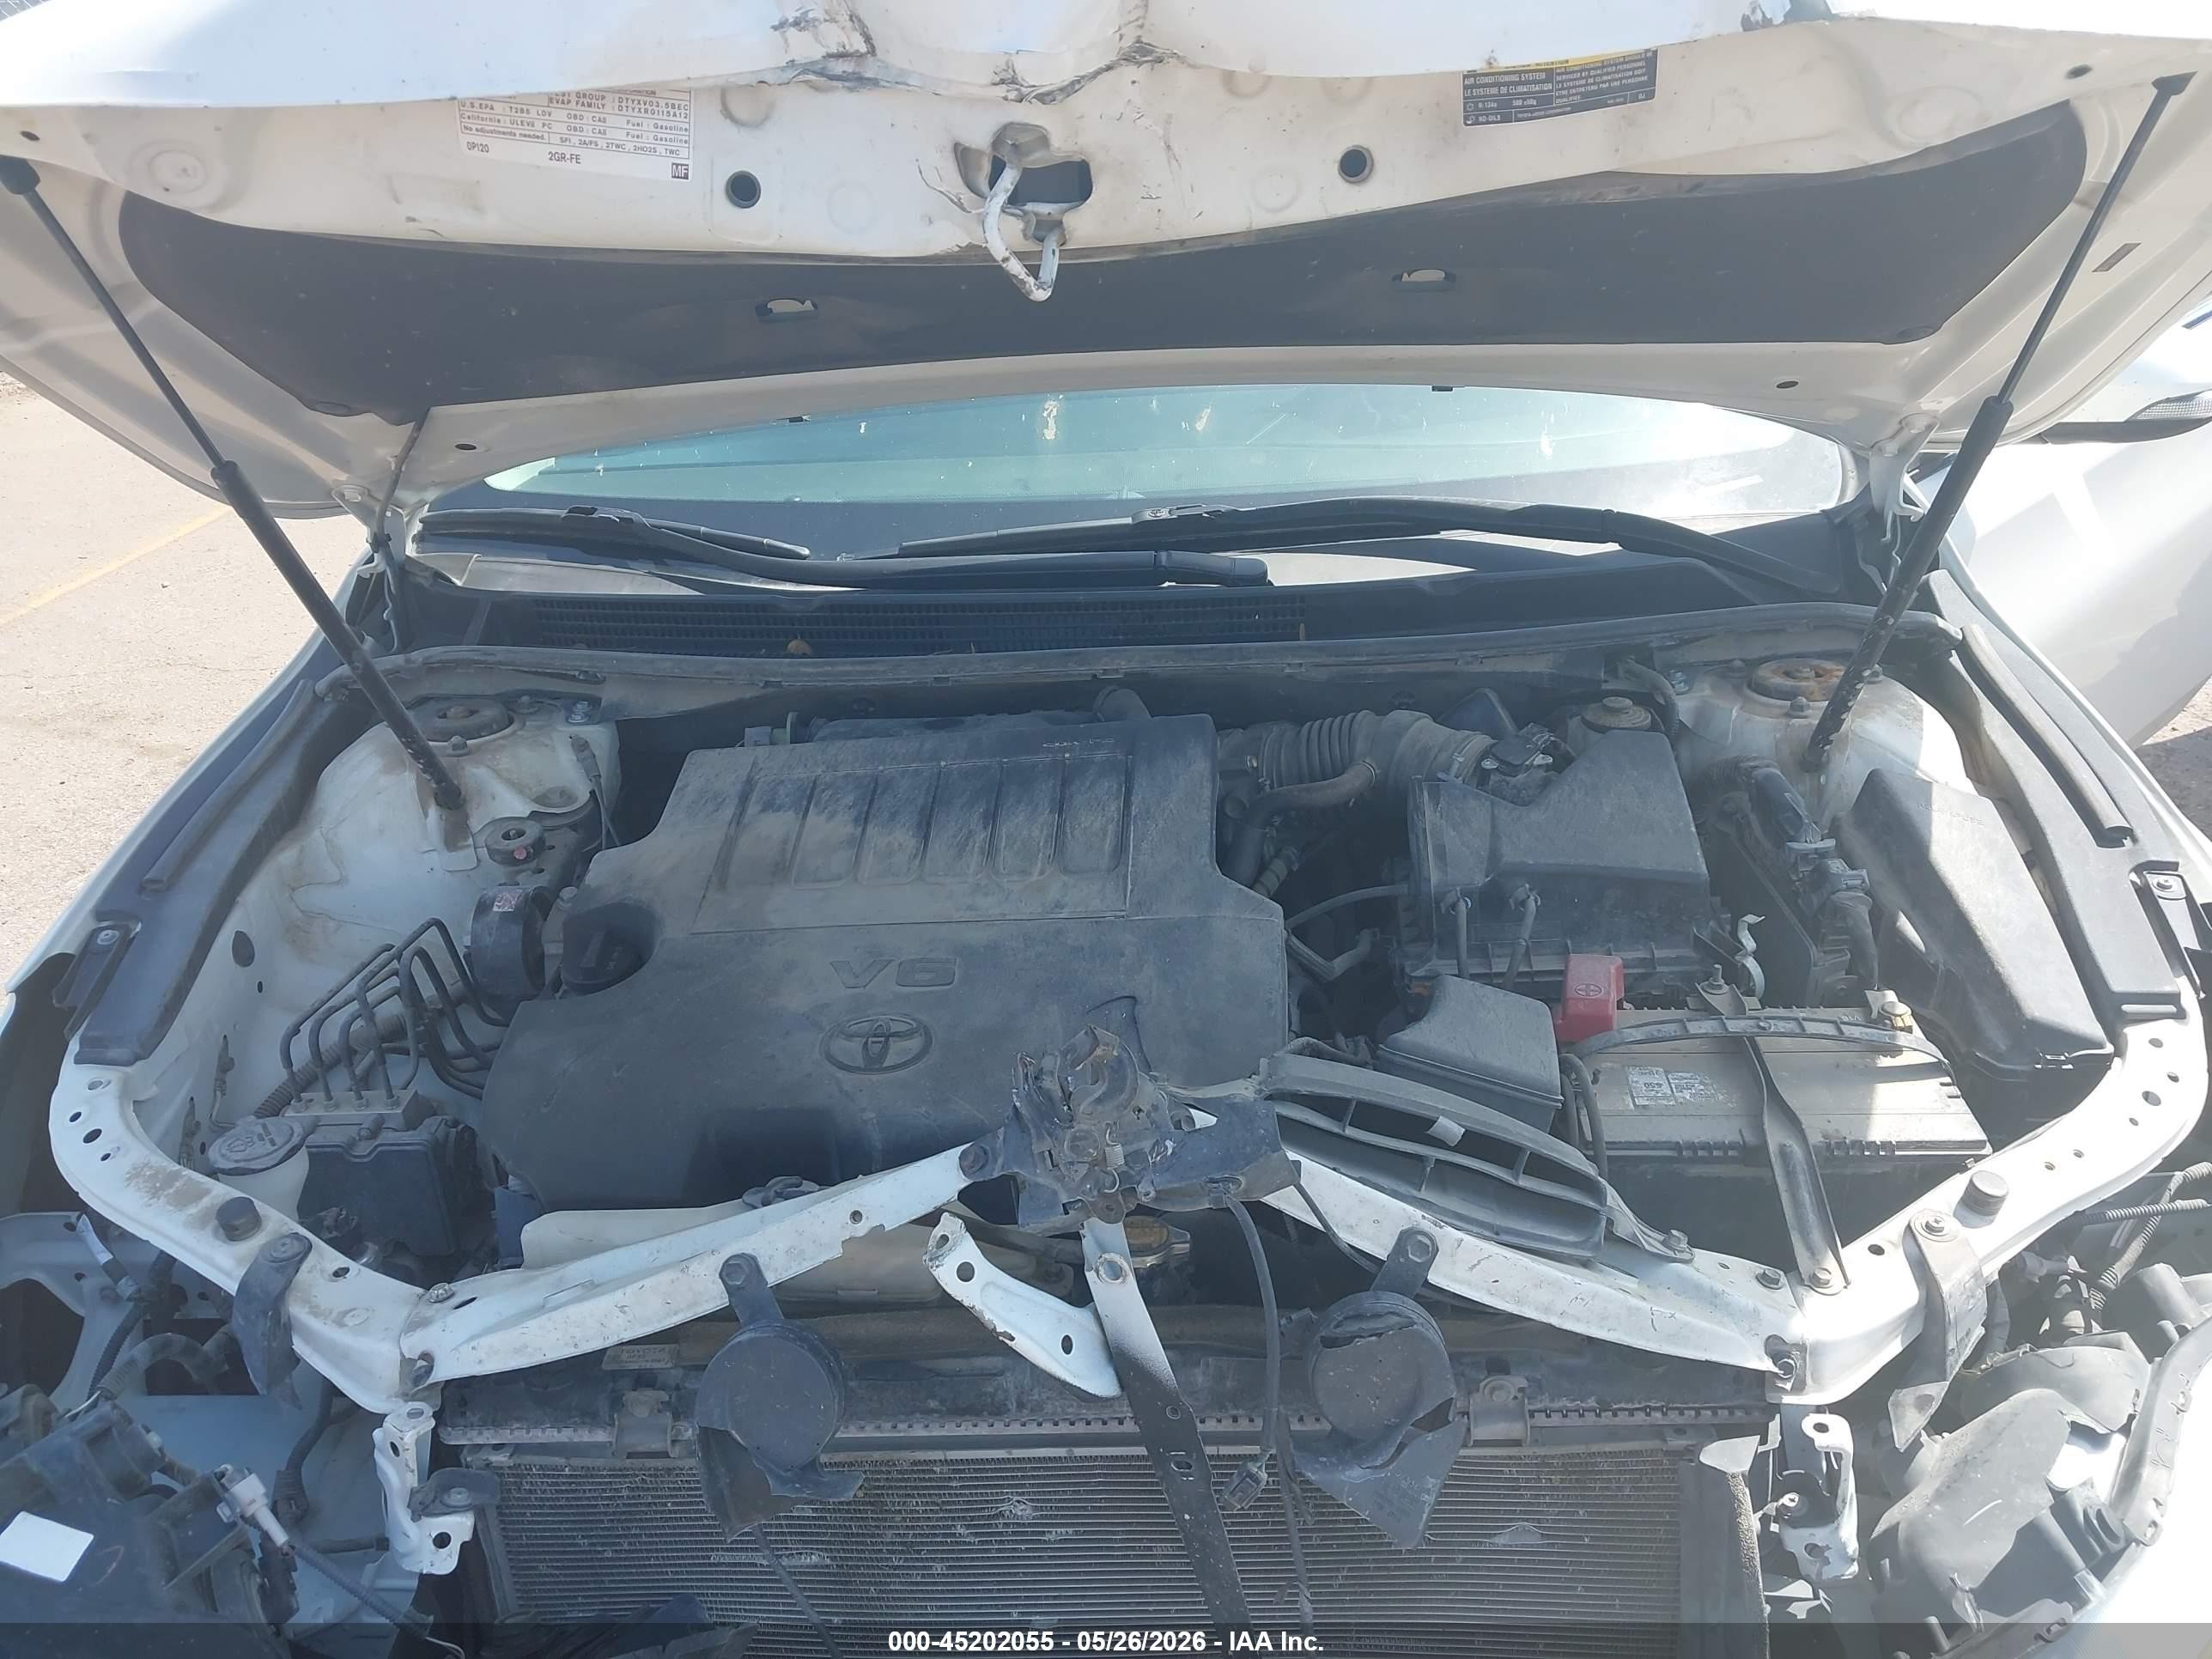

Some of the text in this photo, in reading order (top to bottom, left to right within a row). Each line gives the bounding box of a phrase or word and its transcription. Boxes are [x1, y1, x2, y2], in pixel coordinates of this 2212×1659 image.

[1521, 72, 1546, 81] SYSTEM
[549, 96, 572, 106] EVAP
[575, 100, 606, 110] FAMILY
[575, 91, 606, 101] GROUP
[460, 112, 501, 125] California
[653, 134, 689, 145] Gasoline
[475, 127, 517, 137] adjustments
[653, 122, 689, 132] Gasoline
[548, 150, 581, 164] 2GR-FE
[672, 164, 689, 179] MF
[830, 957, 957, 989] V6
